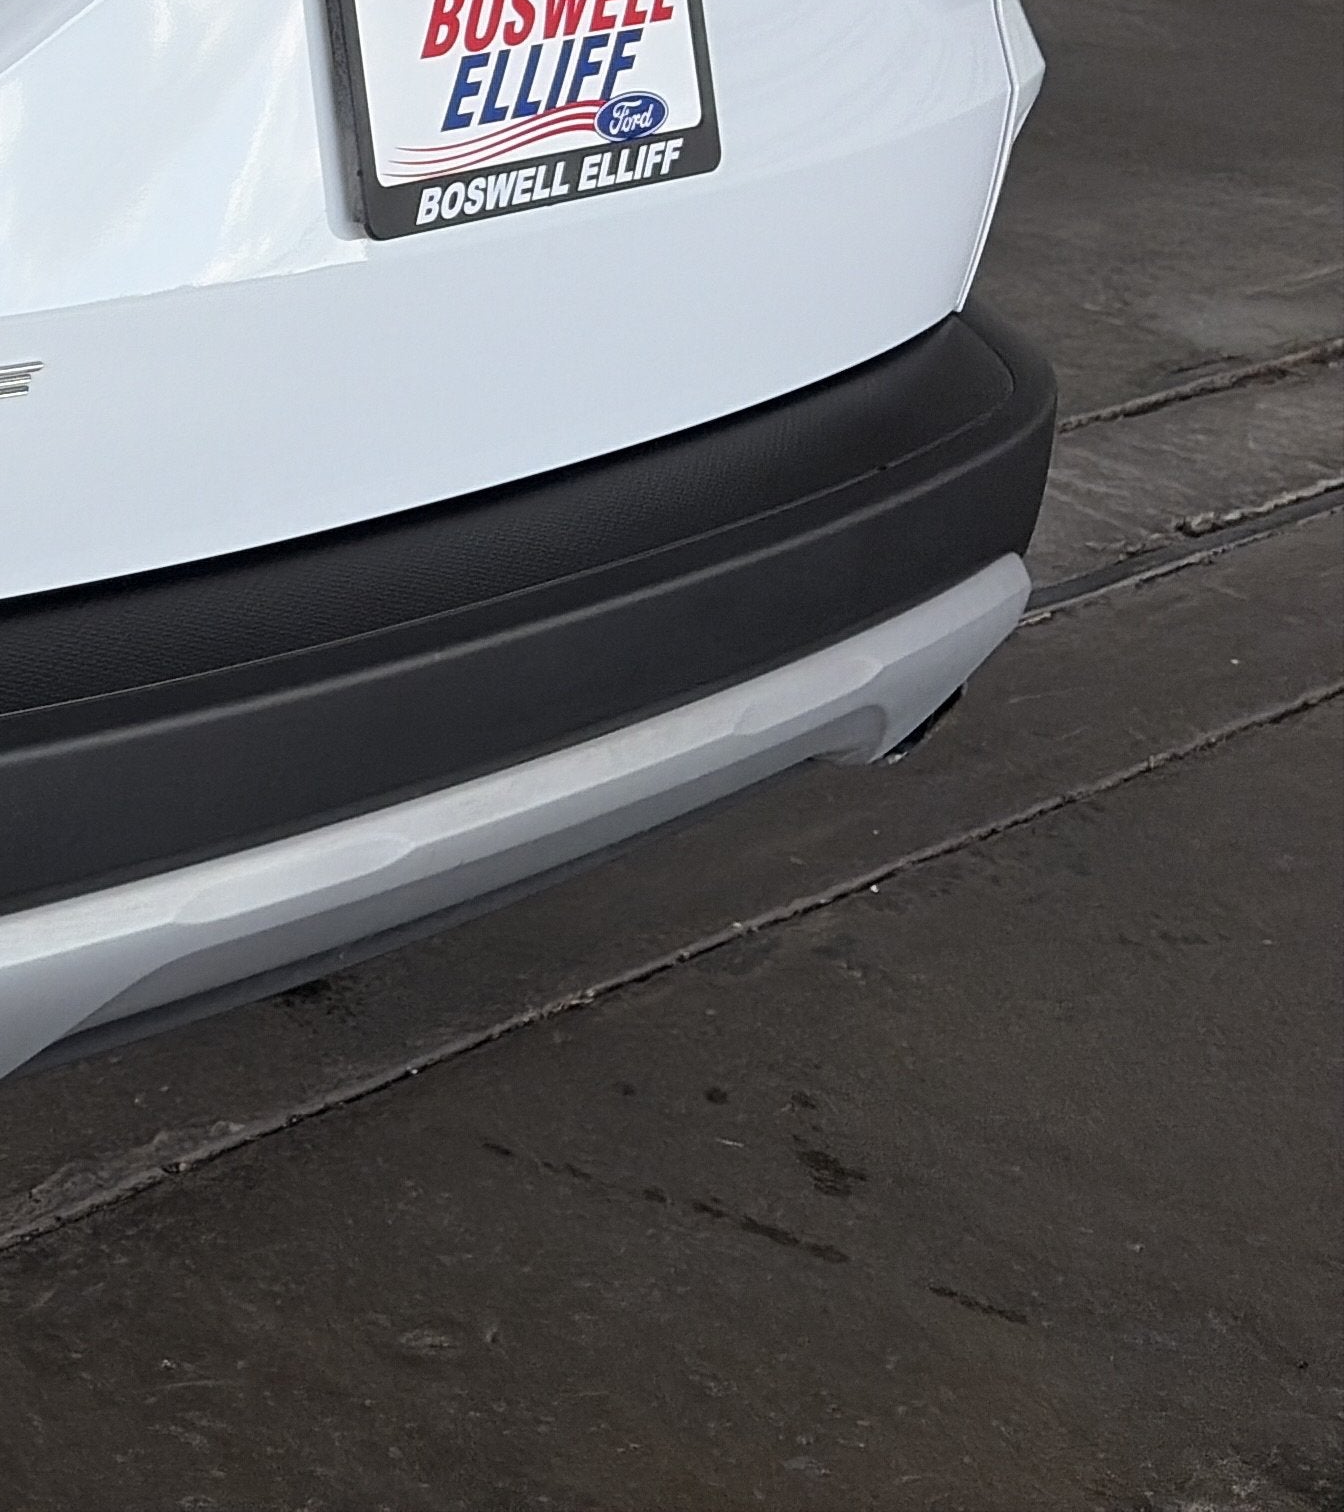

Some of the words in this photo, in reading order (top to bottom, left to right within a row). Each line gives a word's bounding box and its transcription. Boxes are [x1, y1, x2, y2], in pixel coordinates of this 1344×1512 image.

[440, 28, 644, 133] ELLIFF
[608, 99, 655, 137] Ford
[416, 164, 569, 226] BOSWELL
[578, 139, 683, 194] ELLIFF
